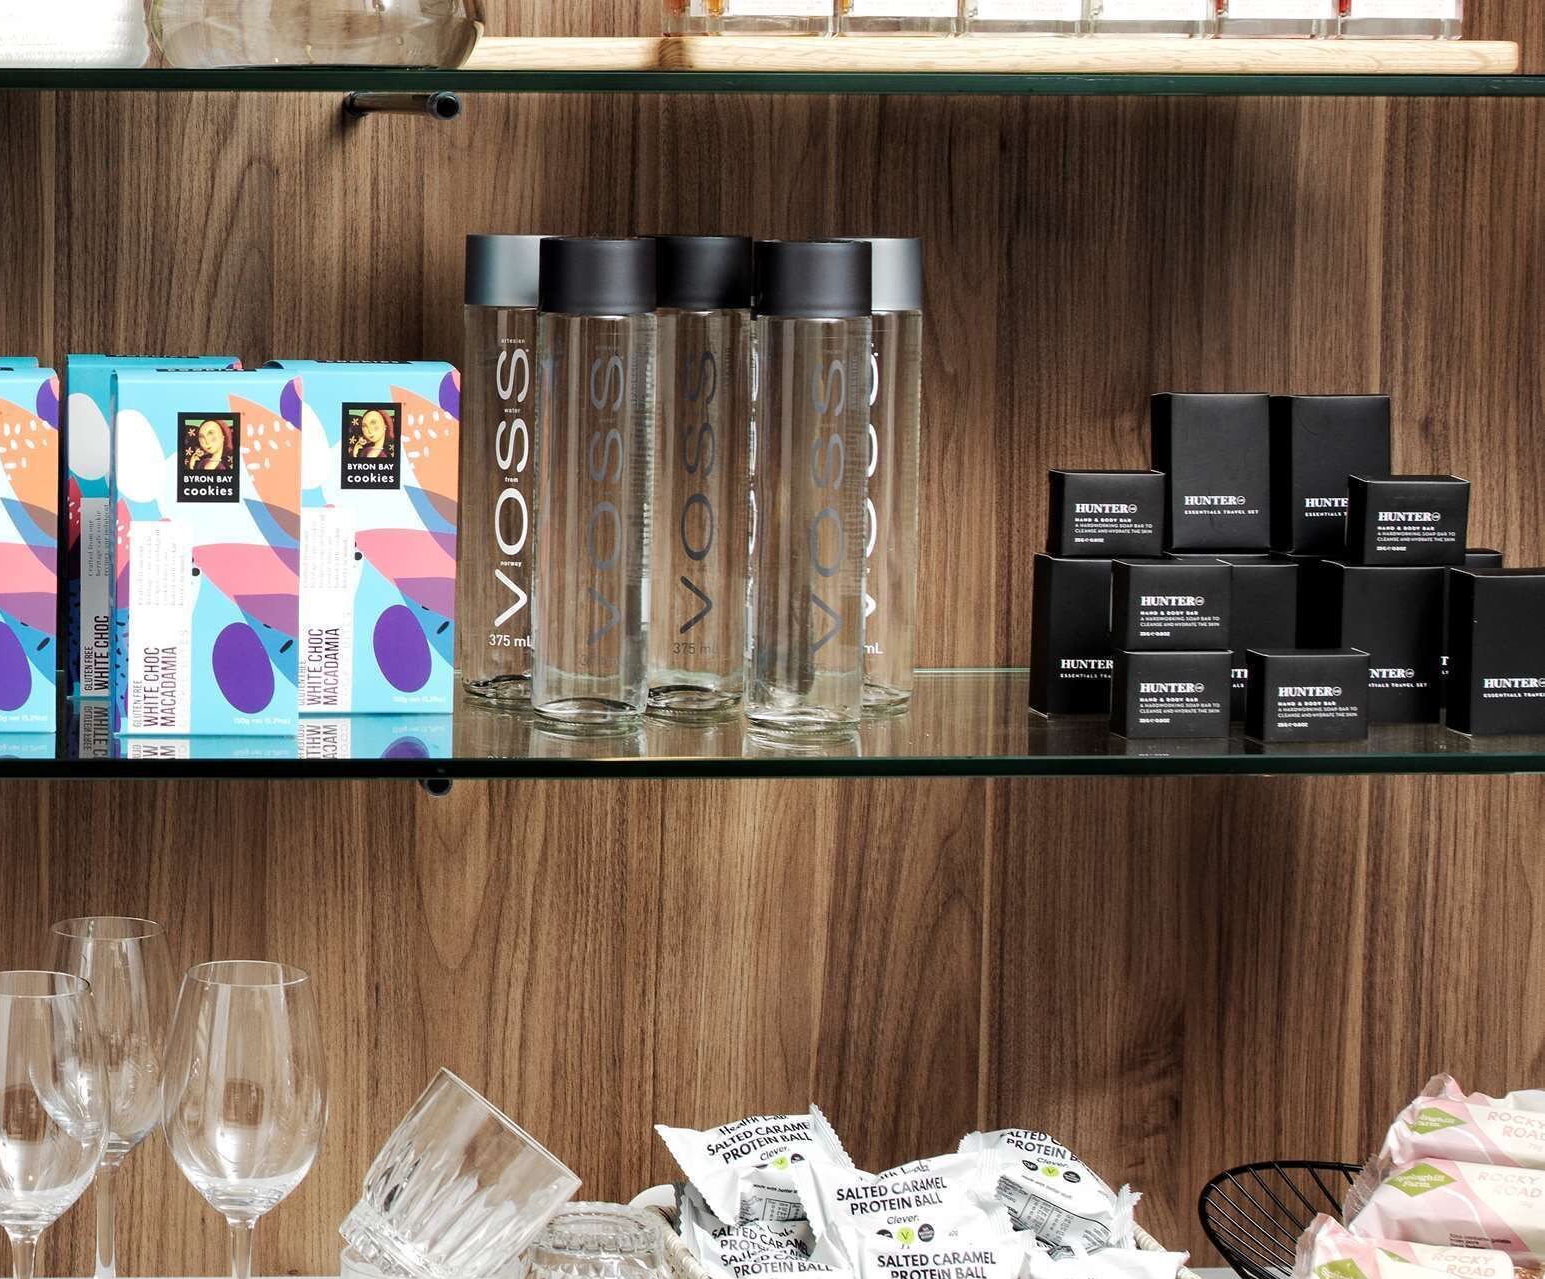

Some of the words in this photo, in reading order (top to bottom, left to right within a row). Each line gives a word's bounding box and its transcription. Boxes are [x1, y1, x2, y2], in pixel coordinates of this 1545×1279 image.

[183, 475, 214, 483] BYRON
[217, 475, 233, 483] BAY
[347, 473, 395, 483] cookies
[183, 486, 233, 496] cookies
[494, 348, 531, 628] VOSS
[679, 350, 716, 634] VOSS
[587, 354, 624, 647] VOSS
[811, 359, 847, 656] VOSS
[1075, 504, 1128, 514] HUNTER
[1185, 496, 1237, 505] HUNTER
[1378, 512, 1431, 522] HUNTER
[1140, 596, 1195, 606] HUNTER
[95, 616, 109, 646] CHOC
[308, 628, 323, 662] CHOC
[489, 633, 511, 647] 375
[514, 633, 531, 647] mL
[85, 646, 93, 664] FREE
[95, 648, 109, 691] WHITE
[144, 647, 159, 682] CHOC
[324, 628, 340, 705] MACADAMIA
[1061, 659, 1113, 669] HUNTER
[85, 665, 93, 691] GLUTEN
[161, 646, 177, 727] MACADAMIA
[307, 665, 322, 706] WHITE
[1483, 678, 1538, 688] HUNTER
[1140, 683, 1195, 693] HUNTER
[1278, 687, 1333, 697] HUNTER
[144, 686, 159, 727] WHITE
[707, 1128, 753, 1156] SALTED
[722, 1135, 778, 1164] PROTEIN
[781, 1132, 813, 1143] BALL
[1007, 1138, 1066, 1159] PROTEIN
[1478, 1172, 1541, 1184] ROCKY
[836, 1185, 888, 1201] SALTED
[891, 1177, 947, 1195] CARAMEL
[1493, 1185, 1542, 1198] ROAD
[851, 1196, 911, 1215] PROTEIN
[915, 1192, 943, 1207] BALL
[712, 1226, 757, 1239] SALTED
[877, 1254, 928, 1268] SALTED
[933, 1252, 996, 1266] CARAMEL
[1431, 1254, 1494, 1266] ROCKY
[733, 1262, 793, 1279] PROTEIN
[798, 1262, 833, 1272] BALL
[956, 1267, 987, 1279] BALL
[1447, 1265, 1496, 1277] ROAD
